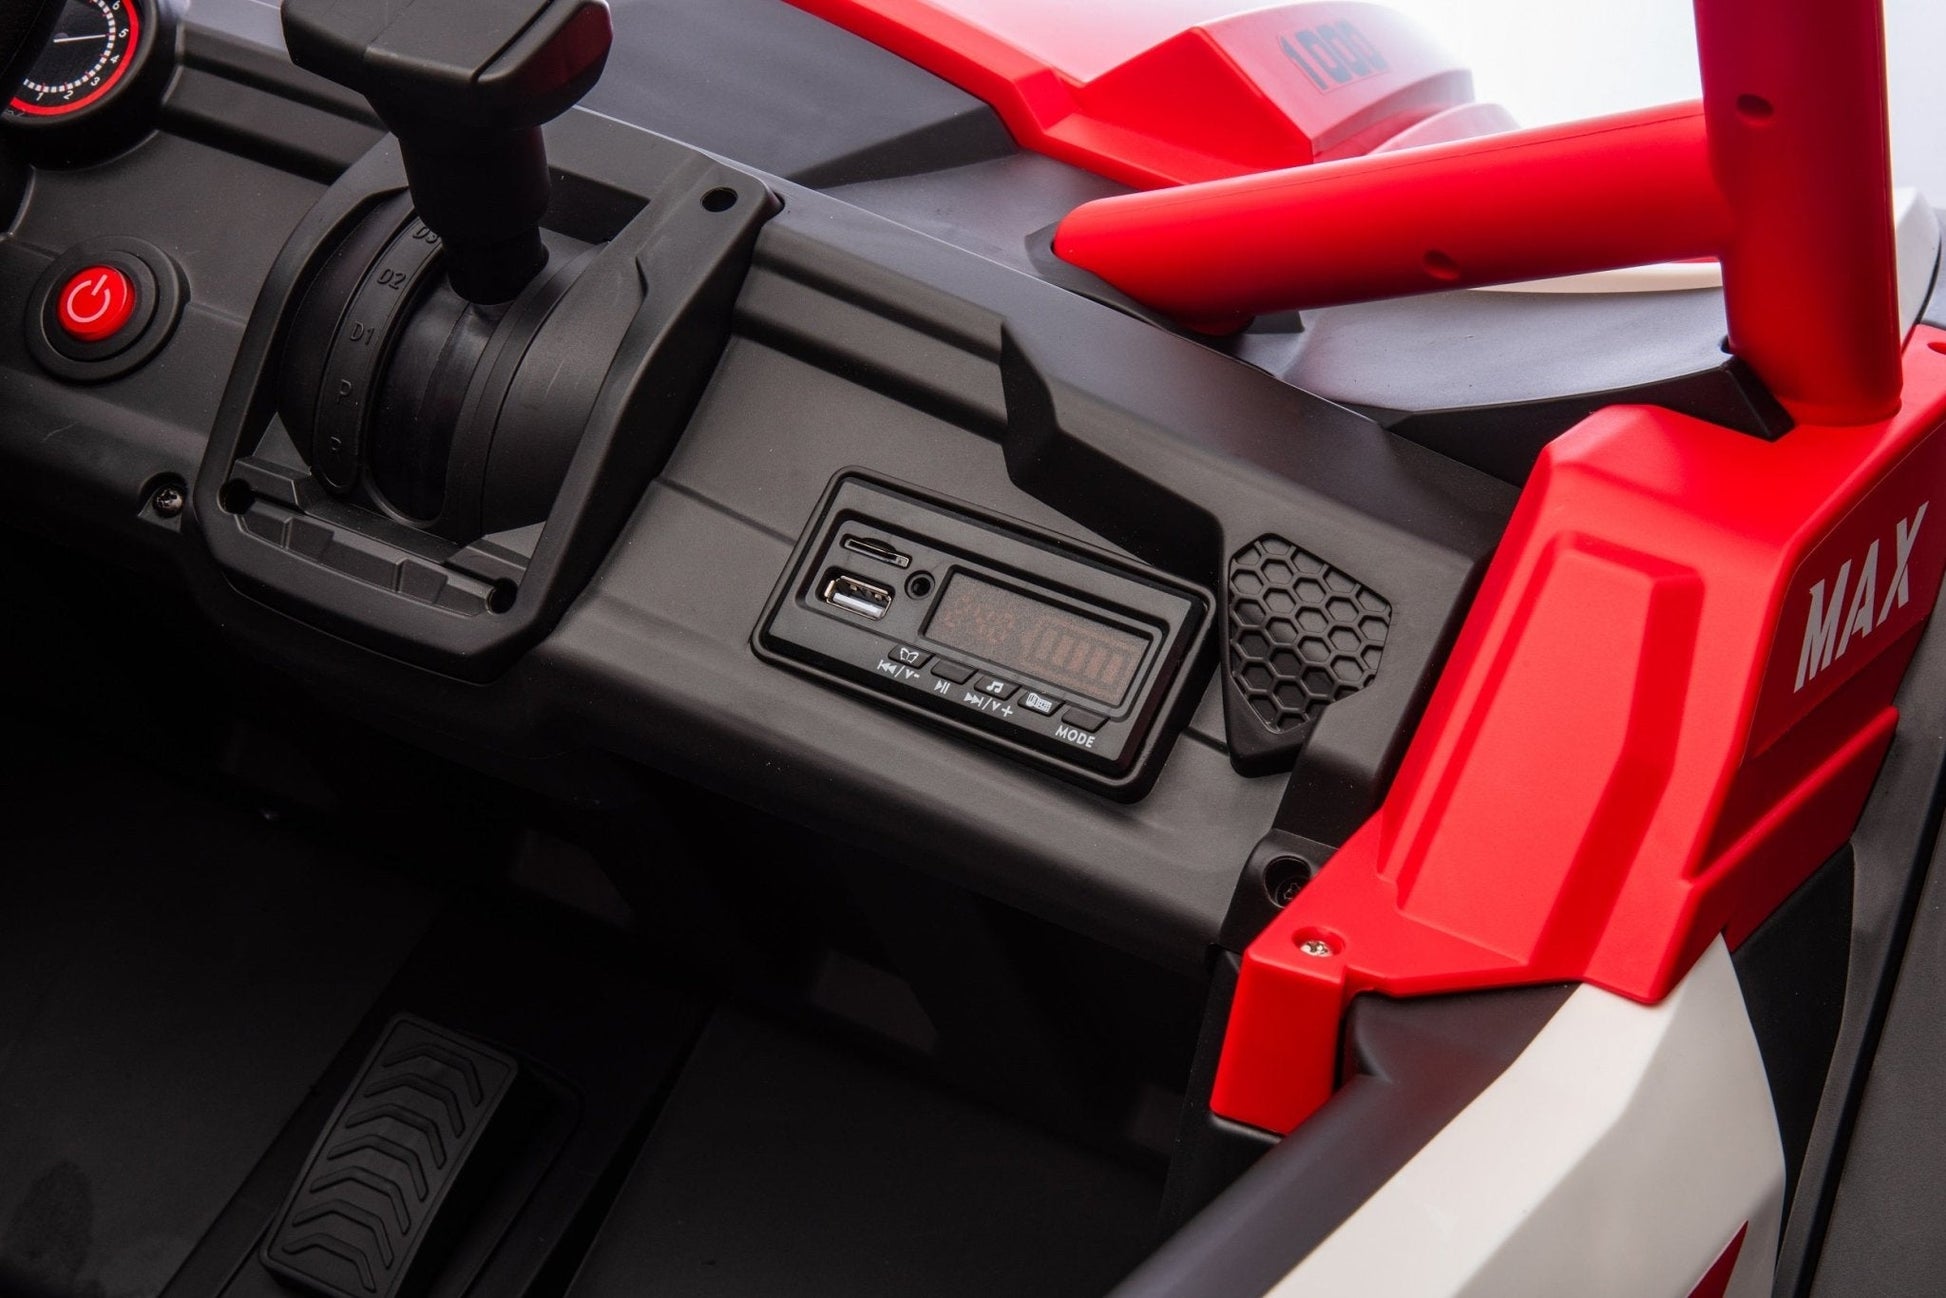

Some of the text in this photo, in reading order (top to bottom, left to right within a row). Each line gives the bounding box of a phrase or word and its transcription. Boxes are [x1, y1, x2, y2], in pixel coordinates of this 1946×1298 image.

[112, 1, 120, 10] 6
[118, 28, 129, 38] 5
[110, 54, 120, 64] 4
[1279, 20, 1388, 90] 1000
[91, 76, 101, 86] 3
[36, 92, 44, 101] 1
[63, 90, 74, 100] 2
[377, 268, 406, 290] D2
[350, 321, 375, 346] D1
[1793, 500, 1930, 694] MAX
[1055, 725, 1095, 748] MODE
